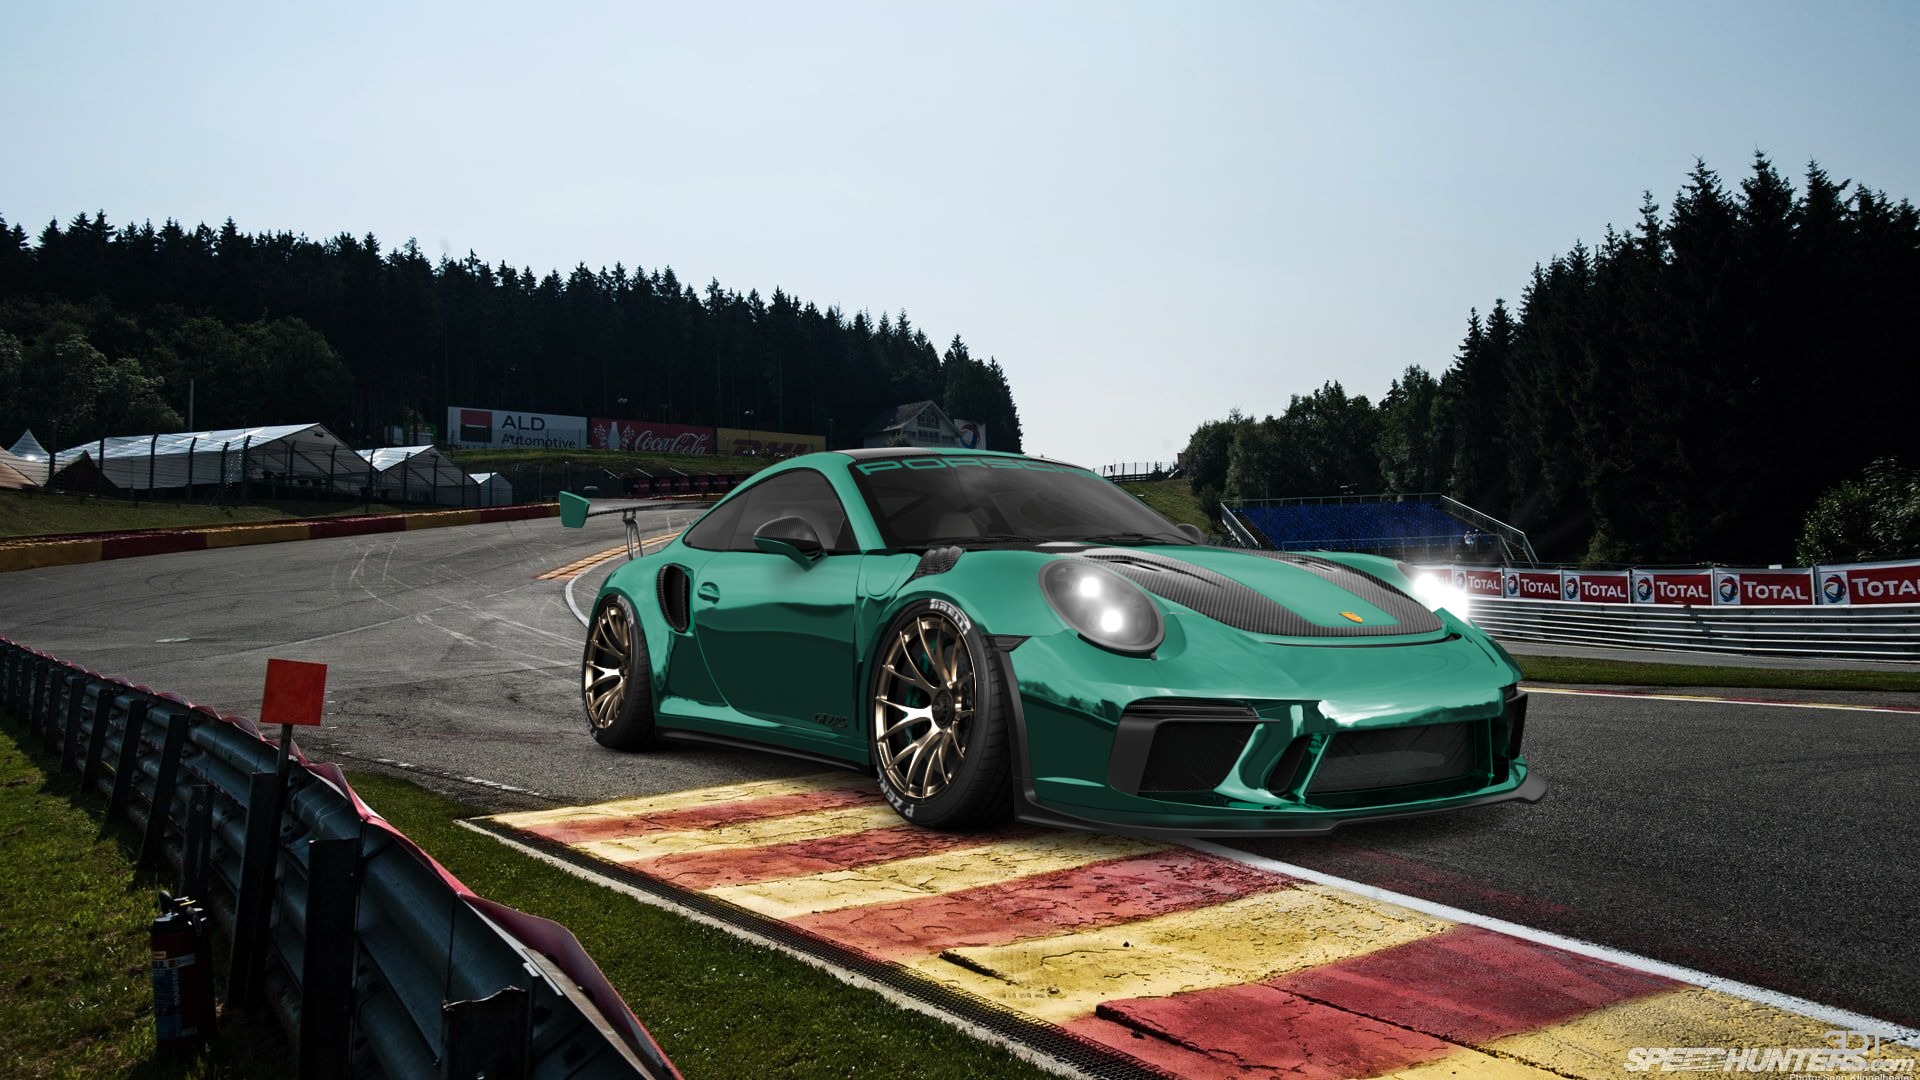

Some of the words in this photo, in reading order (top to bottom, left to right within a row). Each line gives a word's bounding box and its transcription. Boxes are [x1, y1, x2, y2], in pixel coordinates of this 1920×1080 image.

[502, 415, 545, 431] ALD
[501, 433, 576, 449] Automotive
[856, 457, 1094, 476] PORSCH
[1468, 575, 1501, 591] TOTAL
[1521, 578, 1559, 595] TOTAL
[1582, 581, 1627, 598] TOTAL
[1656, 581, 1709, 599] TOTAL
[1742, 581, 1809, 601] TOTAL
[929, 598, 972, 636] PIRELLI
[904, 803, 915, 818] P
